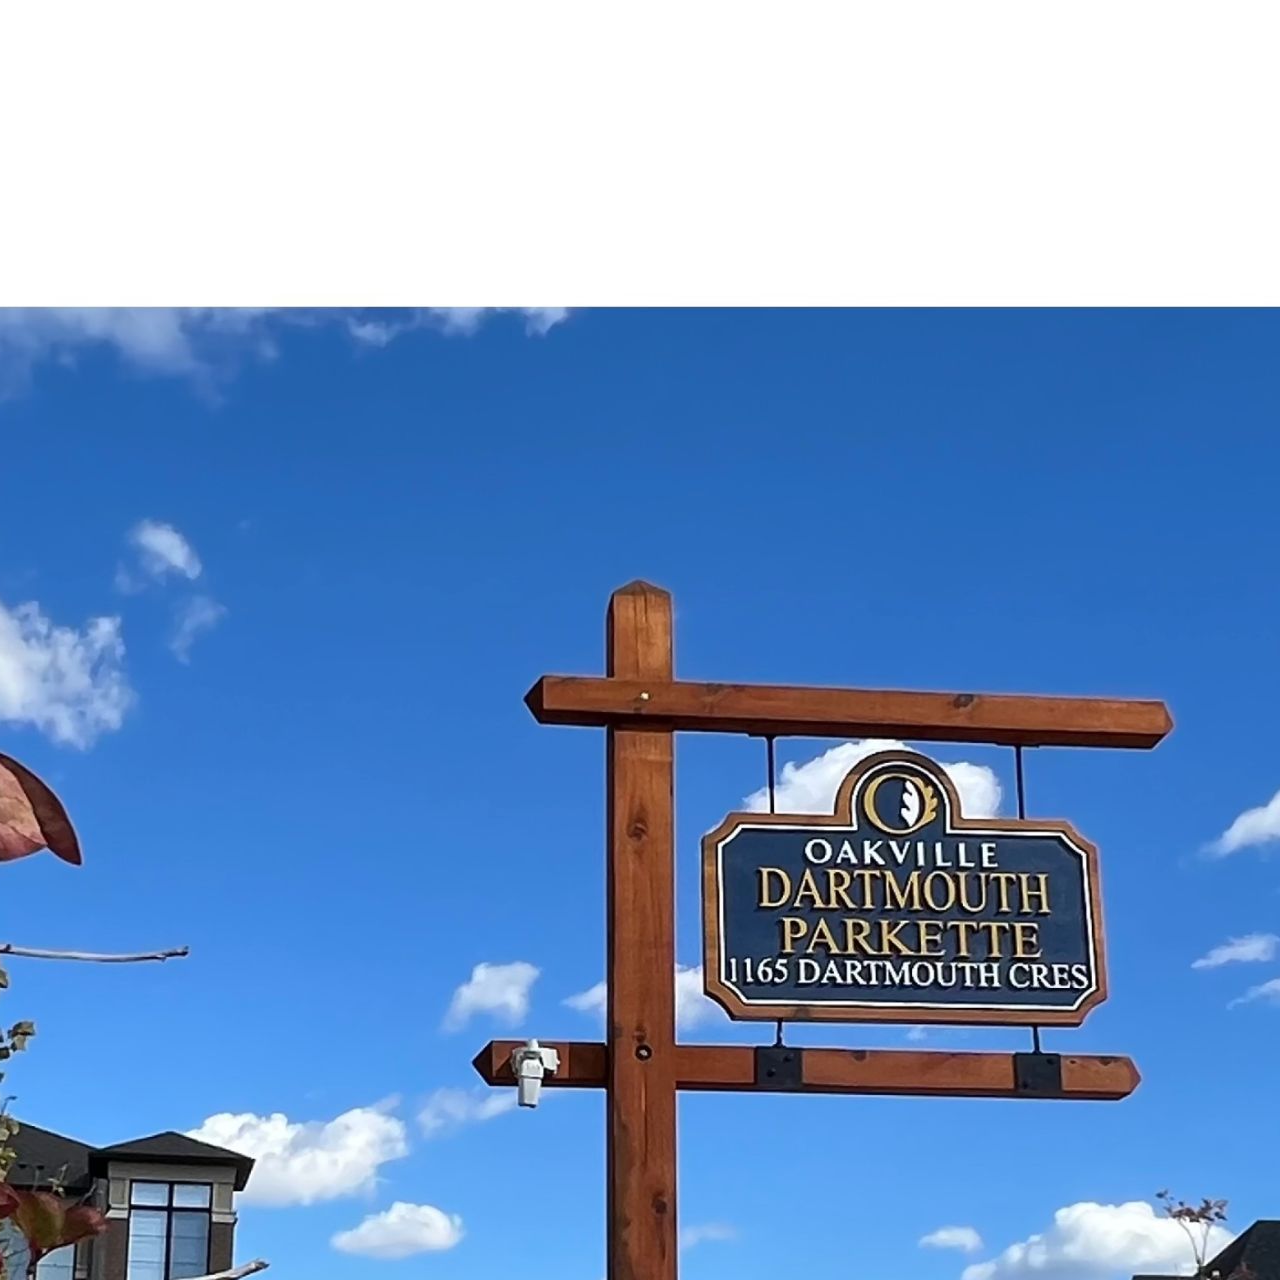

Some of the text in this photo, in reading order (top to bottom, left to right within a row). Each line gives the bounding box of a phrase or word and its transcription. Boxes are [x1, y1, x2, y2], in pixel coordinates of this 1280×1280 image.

[806, 839, 999, 868] OAKVILLE
[758, 867, 1051, 914] DARTMOUTH
[781, 917, 1042, 959] PARKETTE
[728, 958, 1089, 989] 1165 DARTMOUTH CRES
